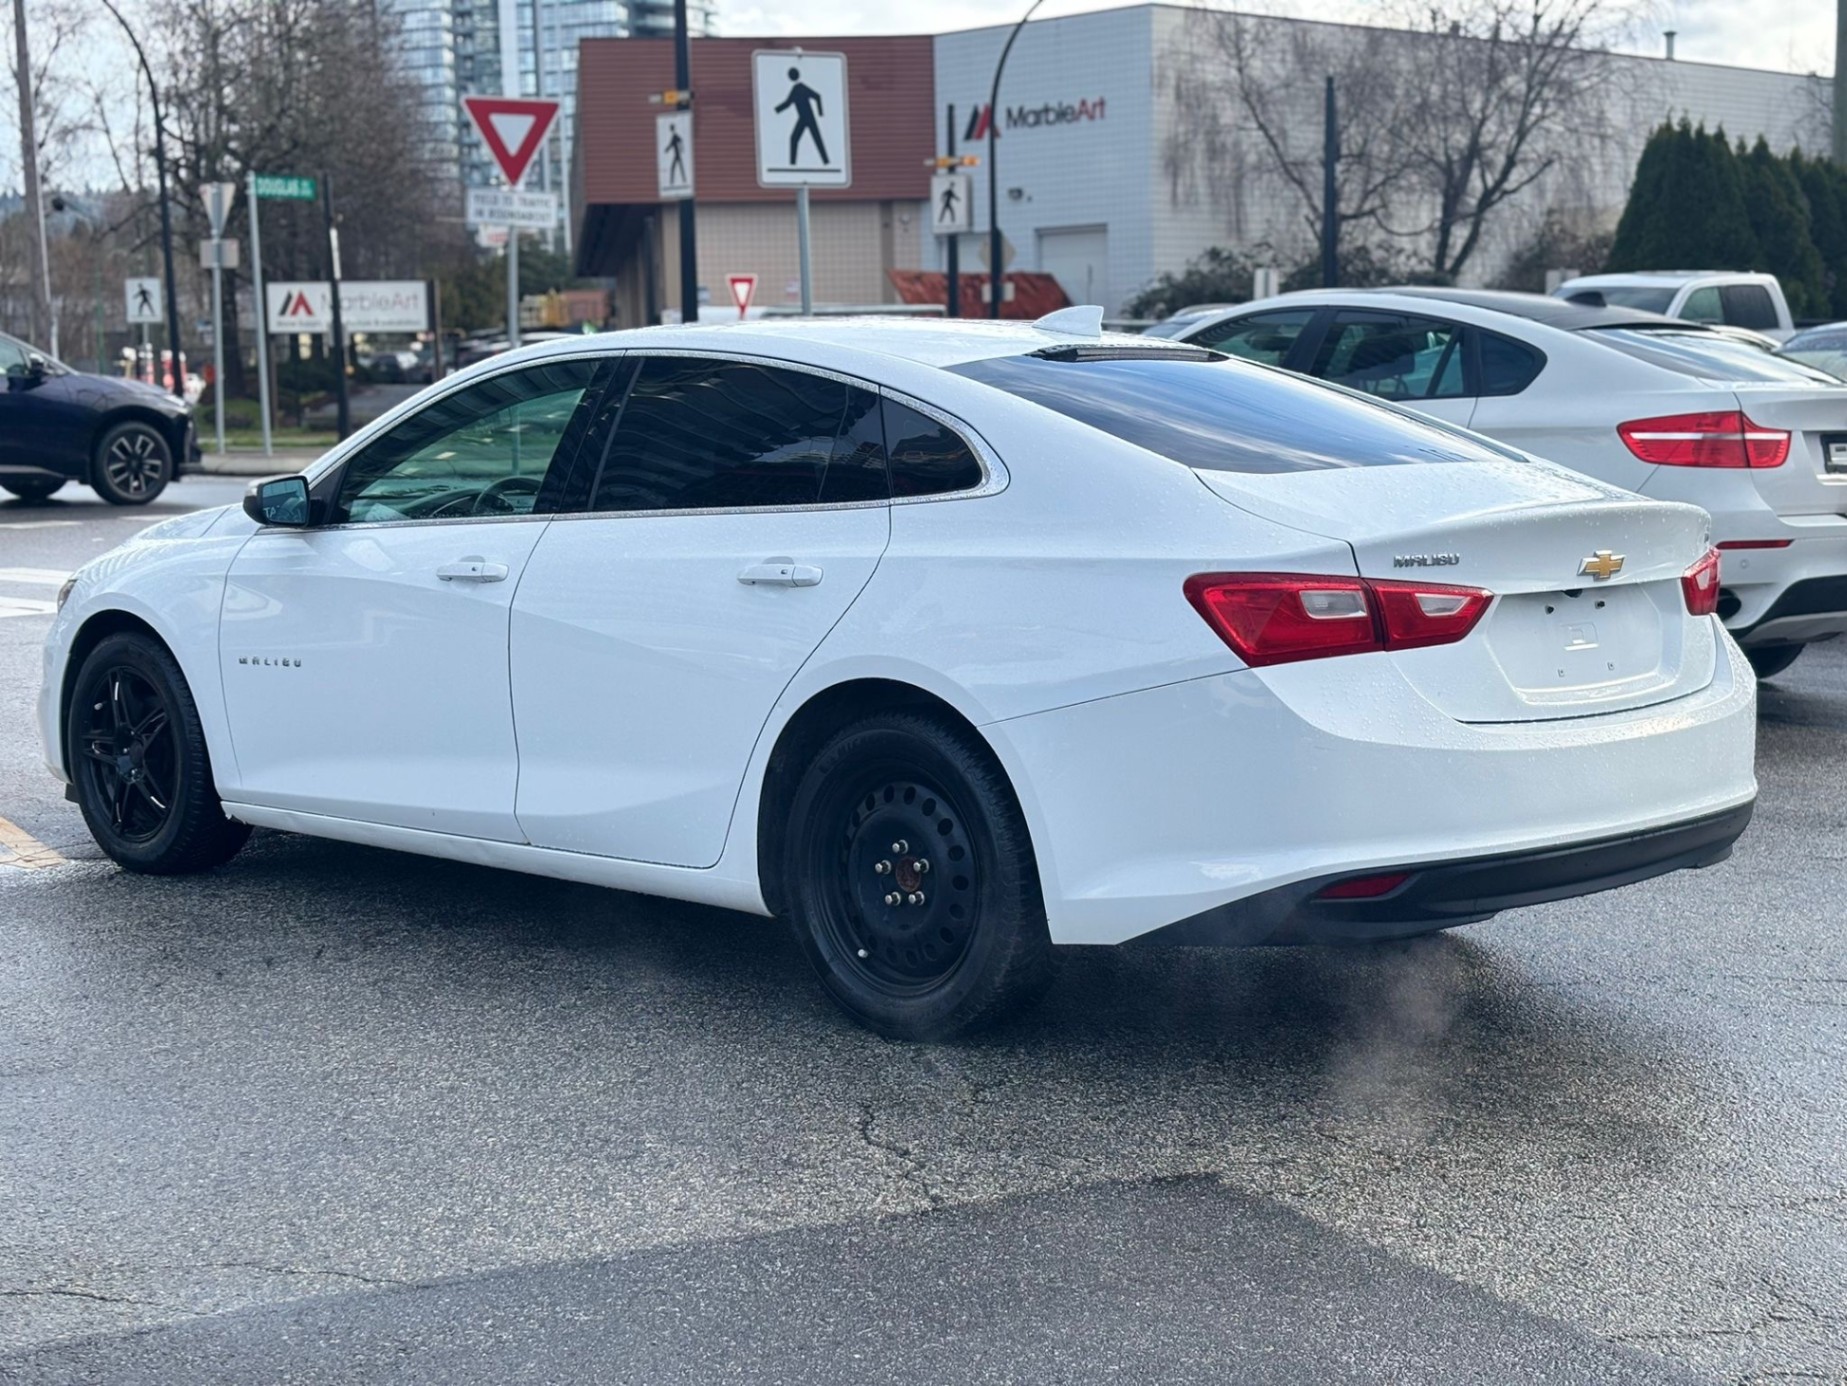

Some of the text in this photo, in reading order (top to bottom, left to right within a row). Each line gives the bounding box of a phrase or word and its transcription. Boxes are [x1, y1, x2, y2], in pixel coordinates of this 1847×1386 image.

[1006, 97, 1106, 129] MarbleArt
[1393, 553, 1460, 568] MALIBU
[238, 656, 302, 668] MALIBU
